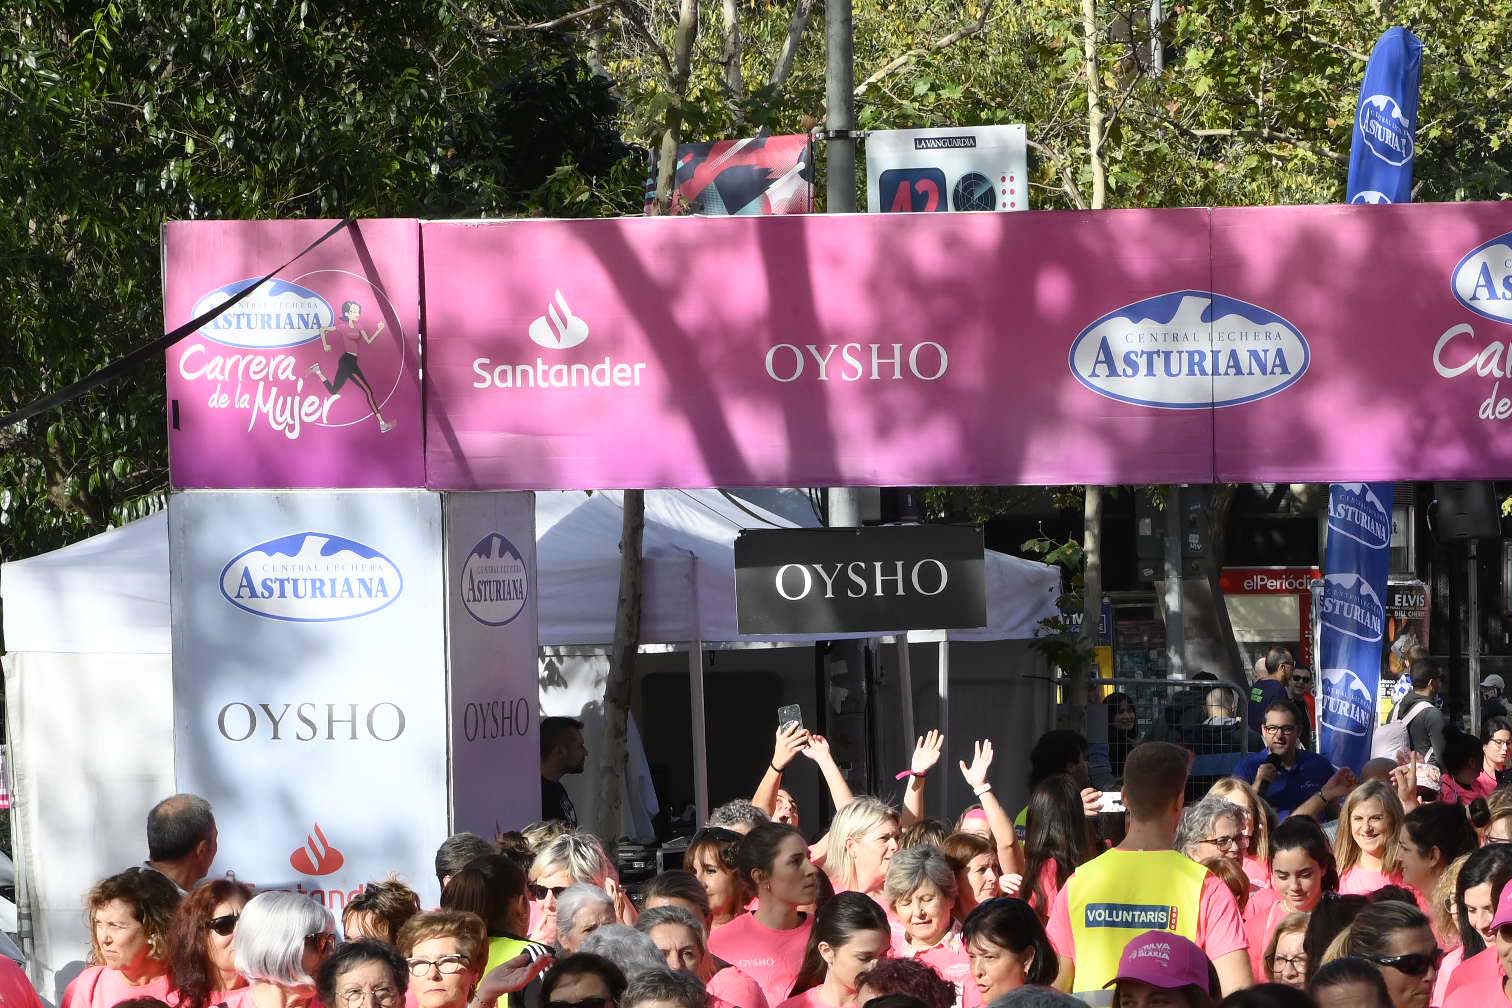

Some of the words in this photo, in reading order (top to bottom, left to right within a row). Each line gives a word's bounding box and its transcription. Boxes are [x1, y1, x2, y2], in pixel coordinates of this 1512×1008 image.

[1125, 331, 1200, 344] CENTRAL
[1207, 329, 1283, 342] LECHERA
[179, 343, 297, 381] Carrera
[472, 355, 647, 390] Santander
[764, 340, 950, 383] OYSHO
[1088, 334, 1292, 379] ASTURIANA
[207, 383, 229, 408] de
[235, 379, 251, 408] la
[247, 377, 341, 440] Mujer
[1478, 382, 1512, 420] de
[234, 565, 390, 600] ASTURIANA
[466, 572, 525, 604] ASTURIANA
[774, 558, 950, 601] OYSHO
[1394, 594, 1425, 607] ELVIS
[217, 701, 407, 743] OYSHO
[463, 697, 530, 743] OYSHO
[1087, 909, 1167, 923] VOLUNTARIS
